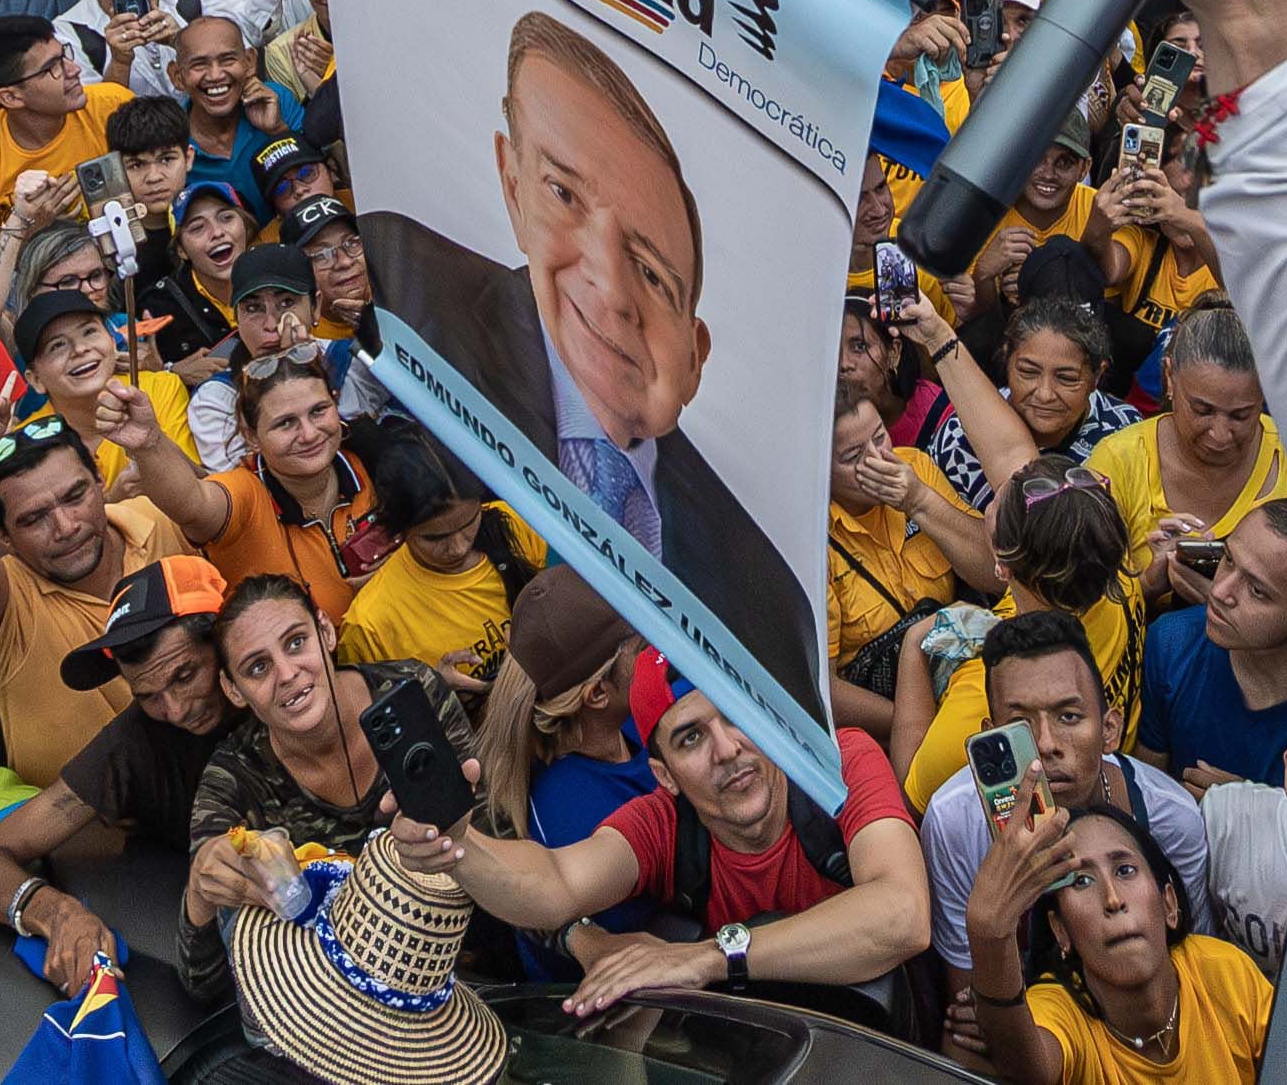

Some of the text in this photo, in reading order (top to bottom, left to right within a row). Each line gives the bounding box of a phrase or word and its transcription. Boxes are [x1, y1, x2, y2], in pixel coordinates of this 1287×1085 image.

[265, 143, 299, 170] JUSTICIA
[698, 40, 847, 176] Democrática
[395, 342, 517, 469] EDMUNDO
[522, 466, 674, 609] GONZÁLEZ
